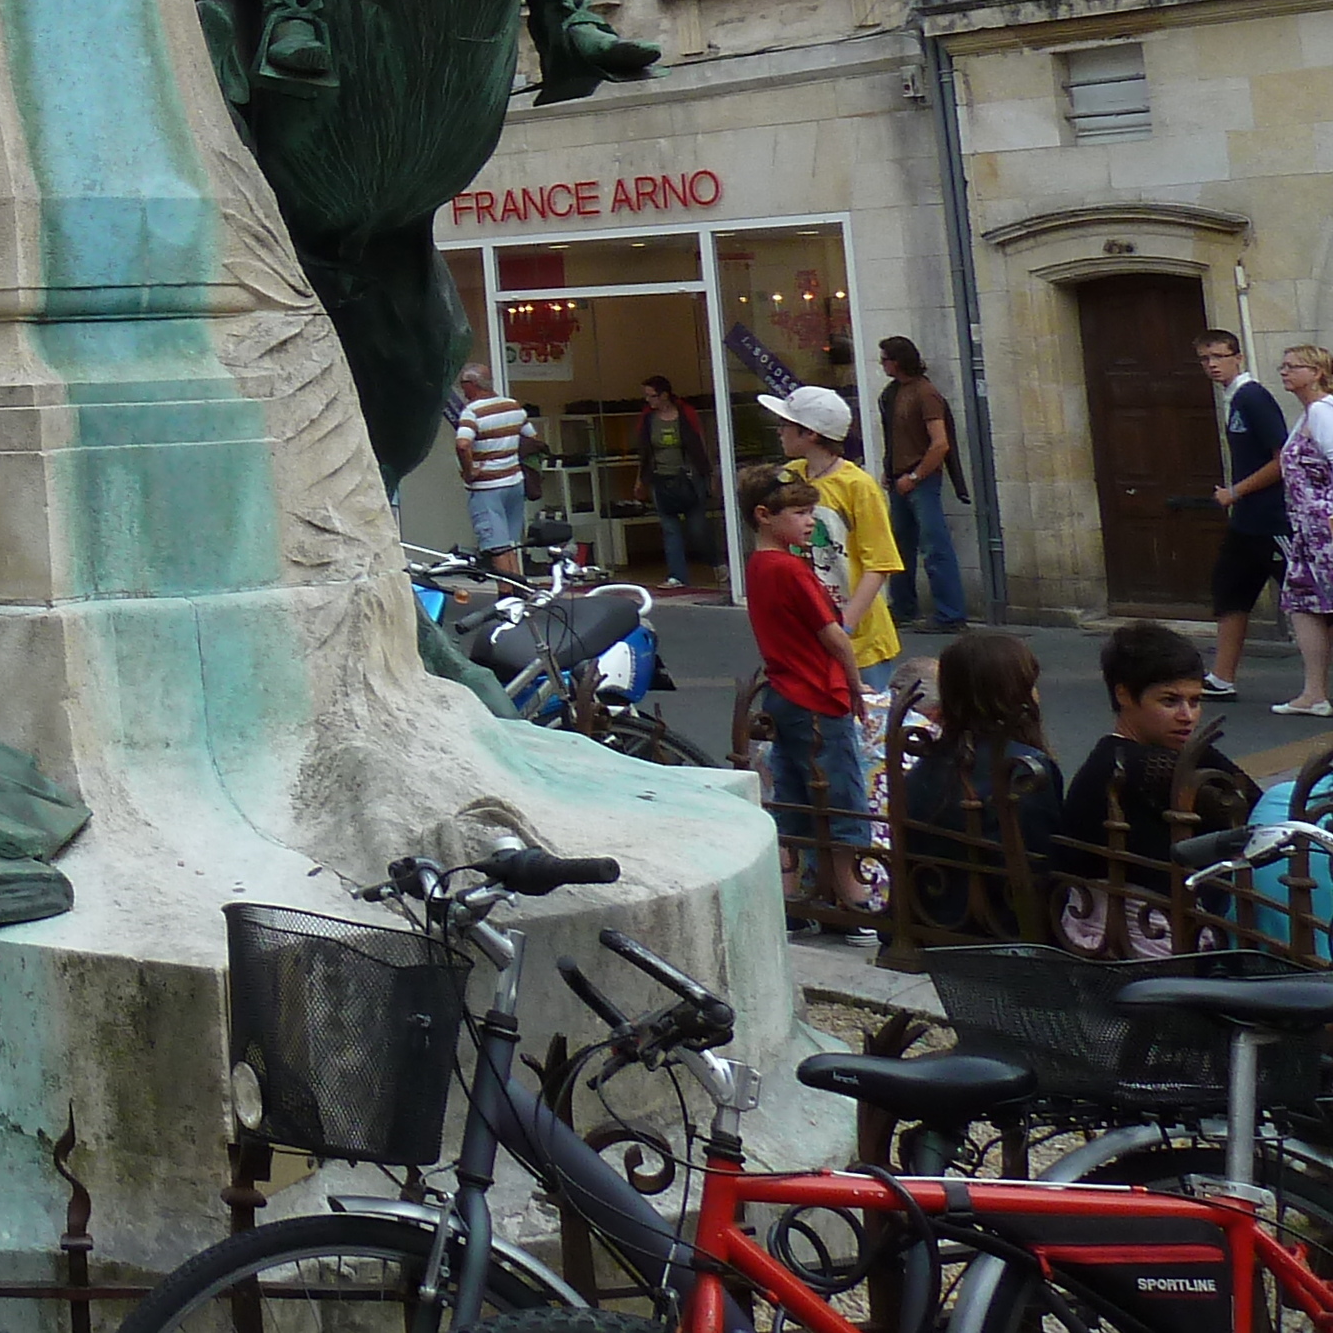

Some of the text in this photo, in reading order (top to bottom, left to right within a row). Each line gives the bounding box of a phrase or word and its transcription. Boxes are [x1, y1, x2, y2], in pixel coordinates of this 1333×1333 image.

[452, 169, 721, 226] FRANCE ARNO
[1137, 1277, 1217, 1293] SPORTLINE
